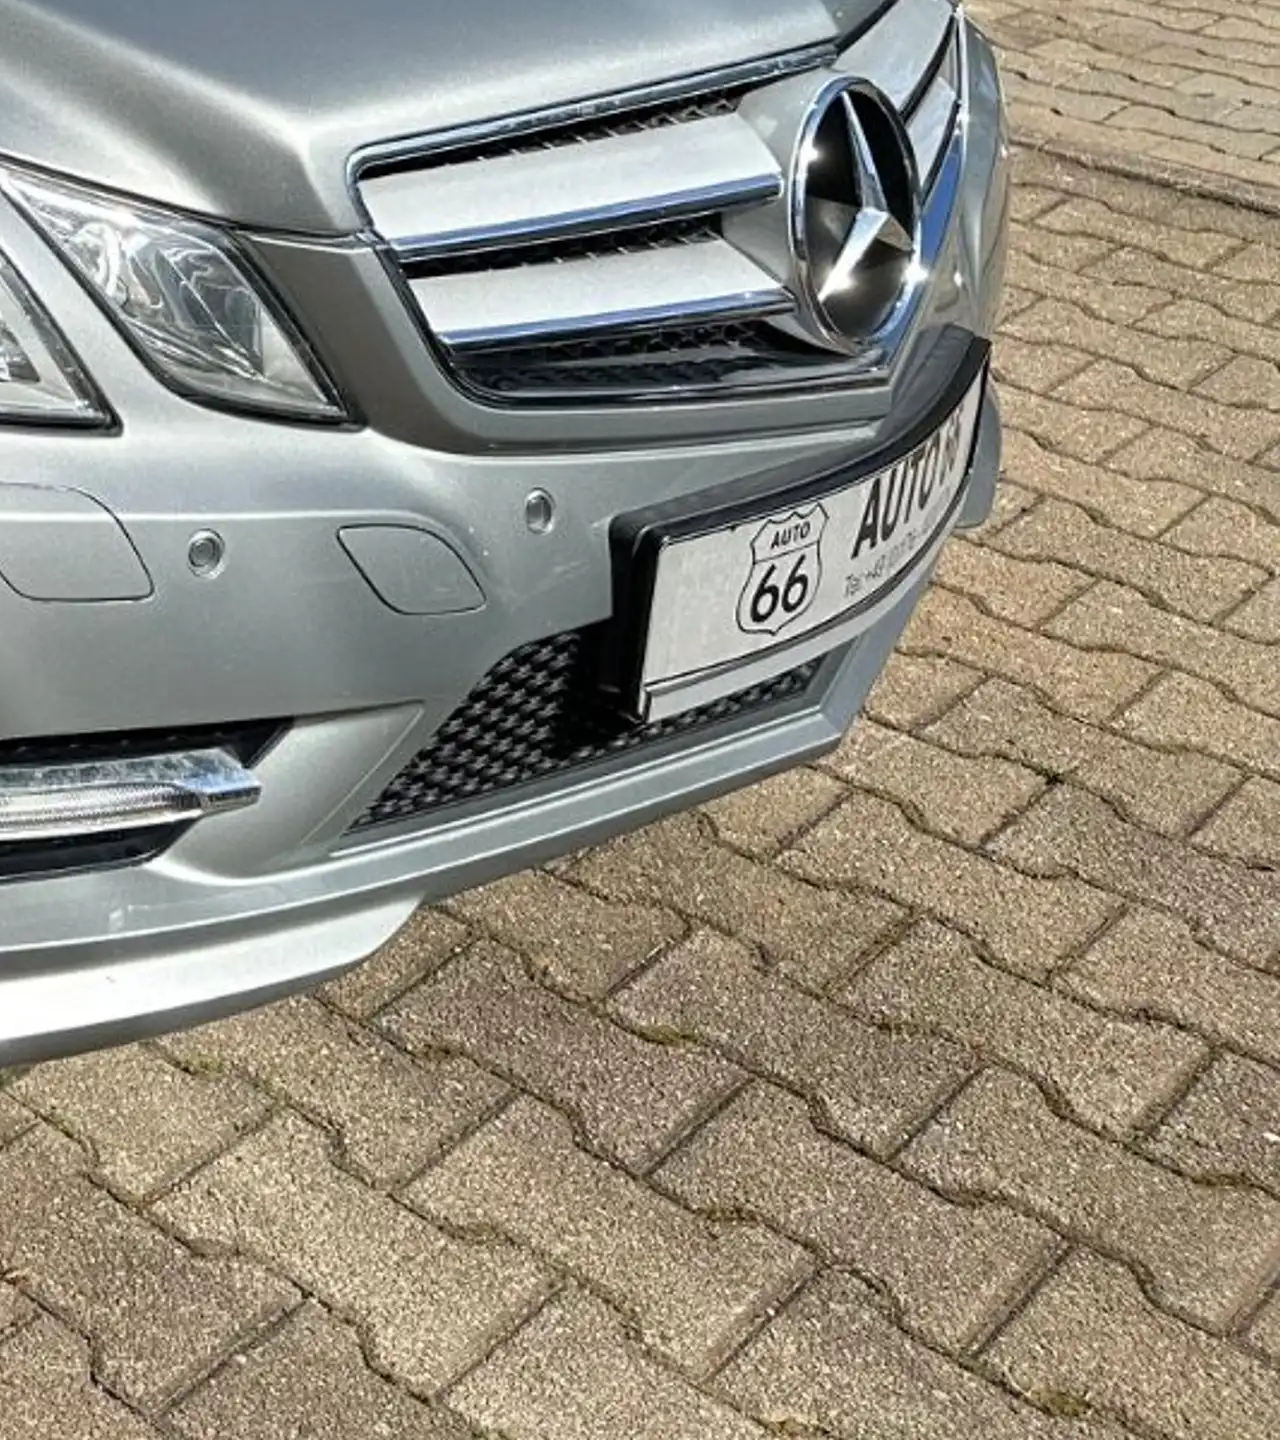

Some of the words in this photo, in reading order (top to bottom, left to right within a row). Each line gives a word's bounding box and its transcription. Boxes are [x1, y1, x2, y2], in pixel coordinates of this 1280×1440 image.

[852, 432, 940, 559] AUTO
[771, 521, 811, 549] AUTO
[750, 554, 808, 623] 66
